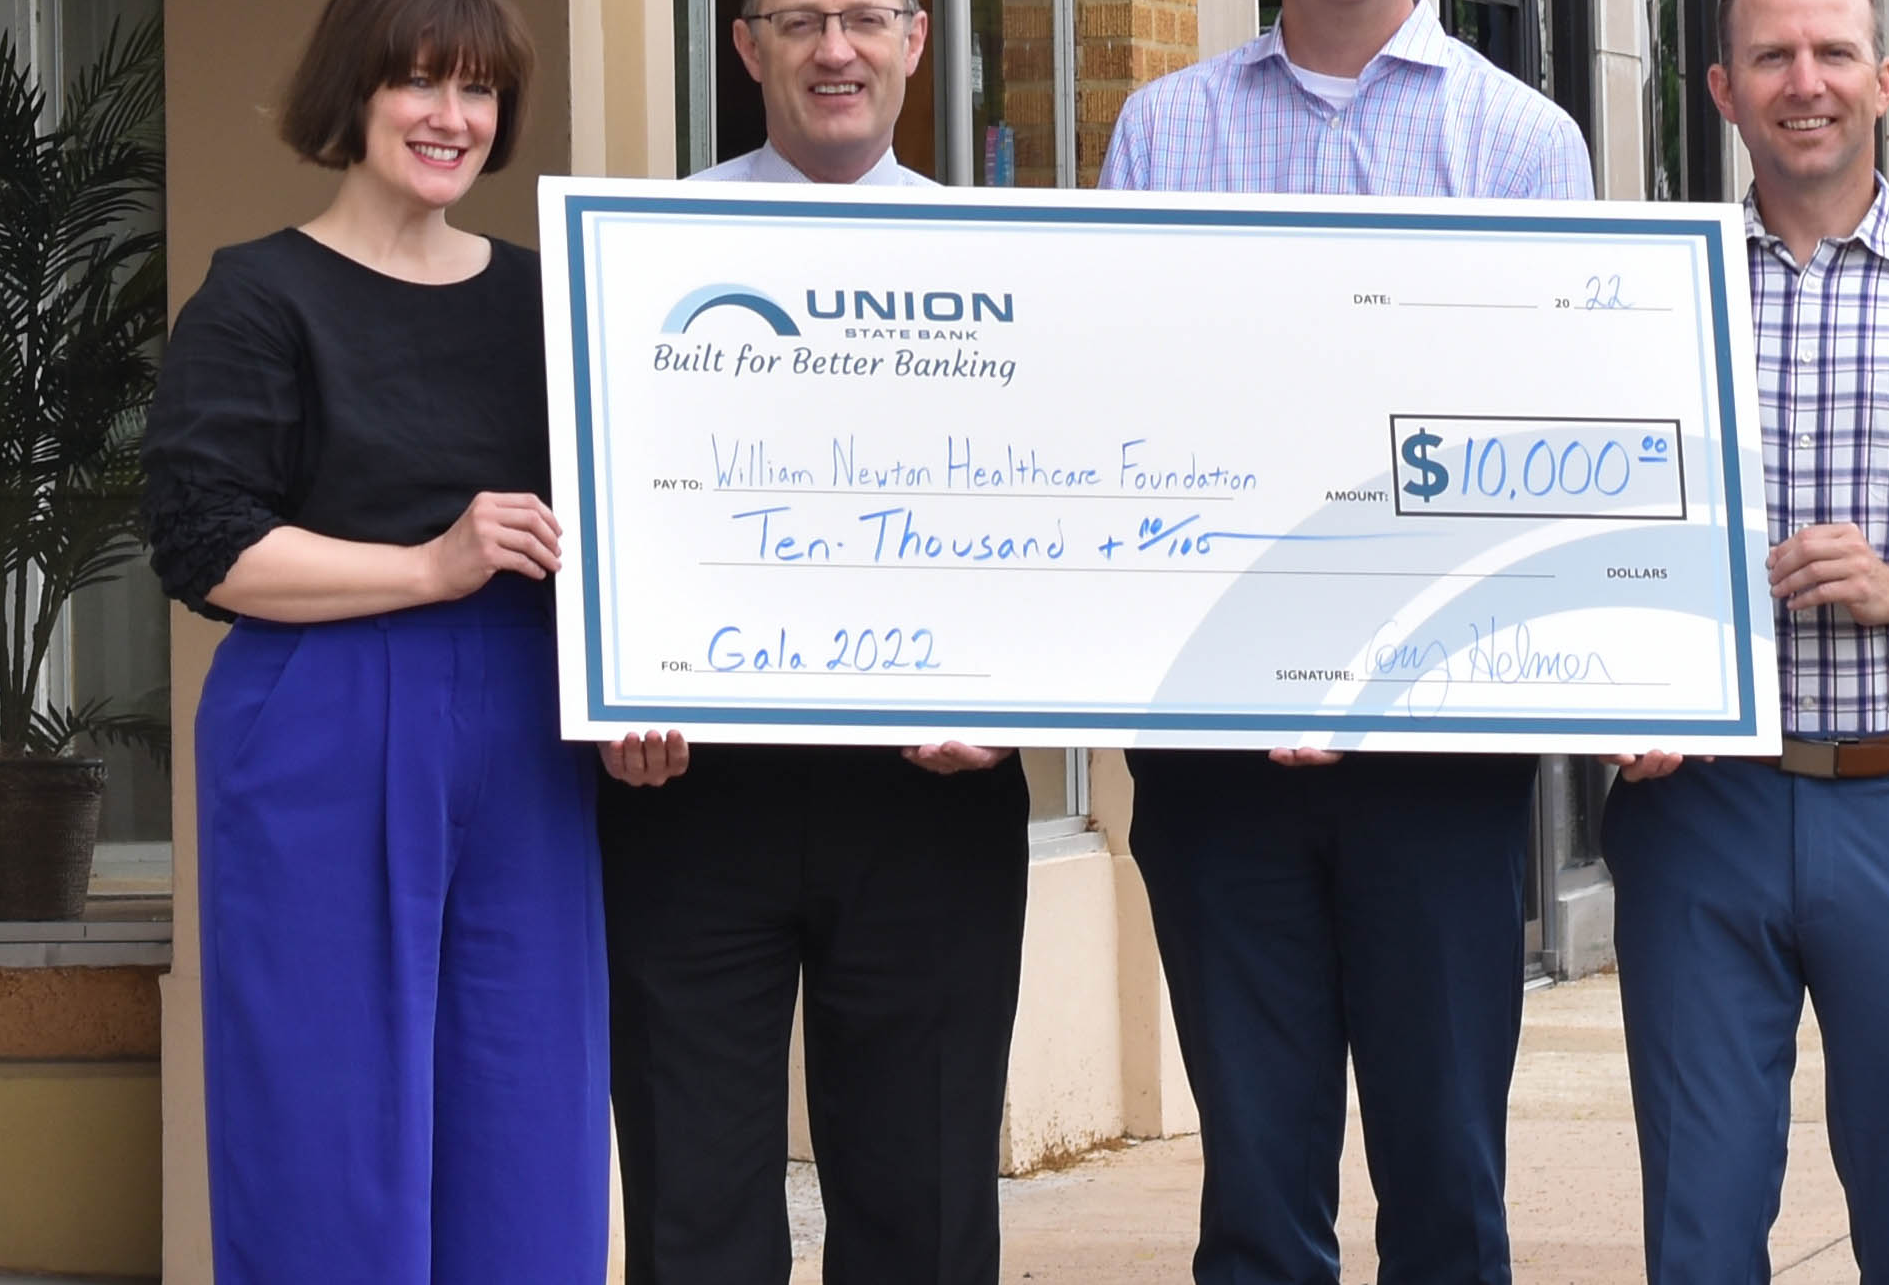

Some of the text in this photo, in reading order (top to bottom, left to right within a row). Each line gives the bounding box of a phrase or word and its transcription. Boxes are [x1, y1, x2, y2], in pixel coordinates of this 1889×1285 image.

[1584, 274, 1633, 311] 22
[806, 289, 1015, 323] UNION
[1353, 293, 1570, 309] DATE: 20
[844, 328, 979, 341] STATE BANK
[653, 342, 1017, 388] Built for Better Banking
[711, 432, 1258, 492] William Newton Healthcare Foundation
[653, 478, 704, 491] PAY TO:
[1325, 490, 1389, 503] AMOUNT:
[859, 507, 1065, 564] Thousand
[1606, 567, 1668, 580] DOLLARS
[707, 625, 942, 672] Gala 2022
[661, 661, 693, 673] FOR:
[1275, 669, 1355, 682] SIGNATURE:
